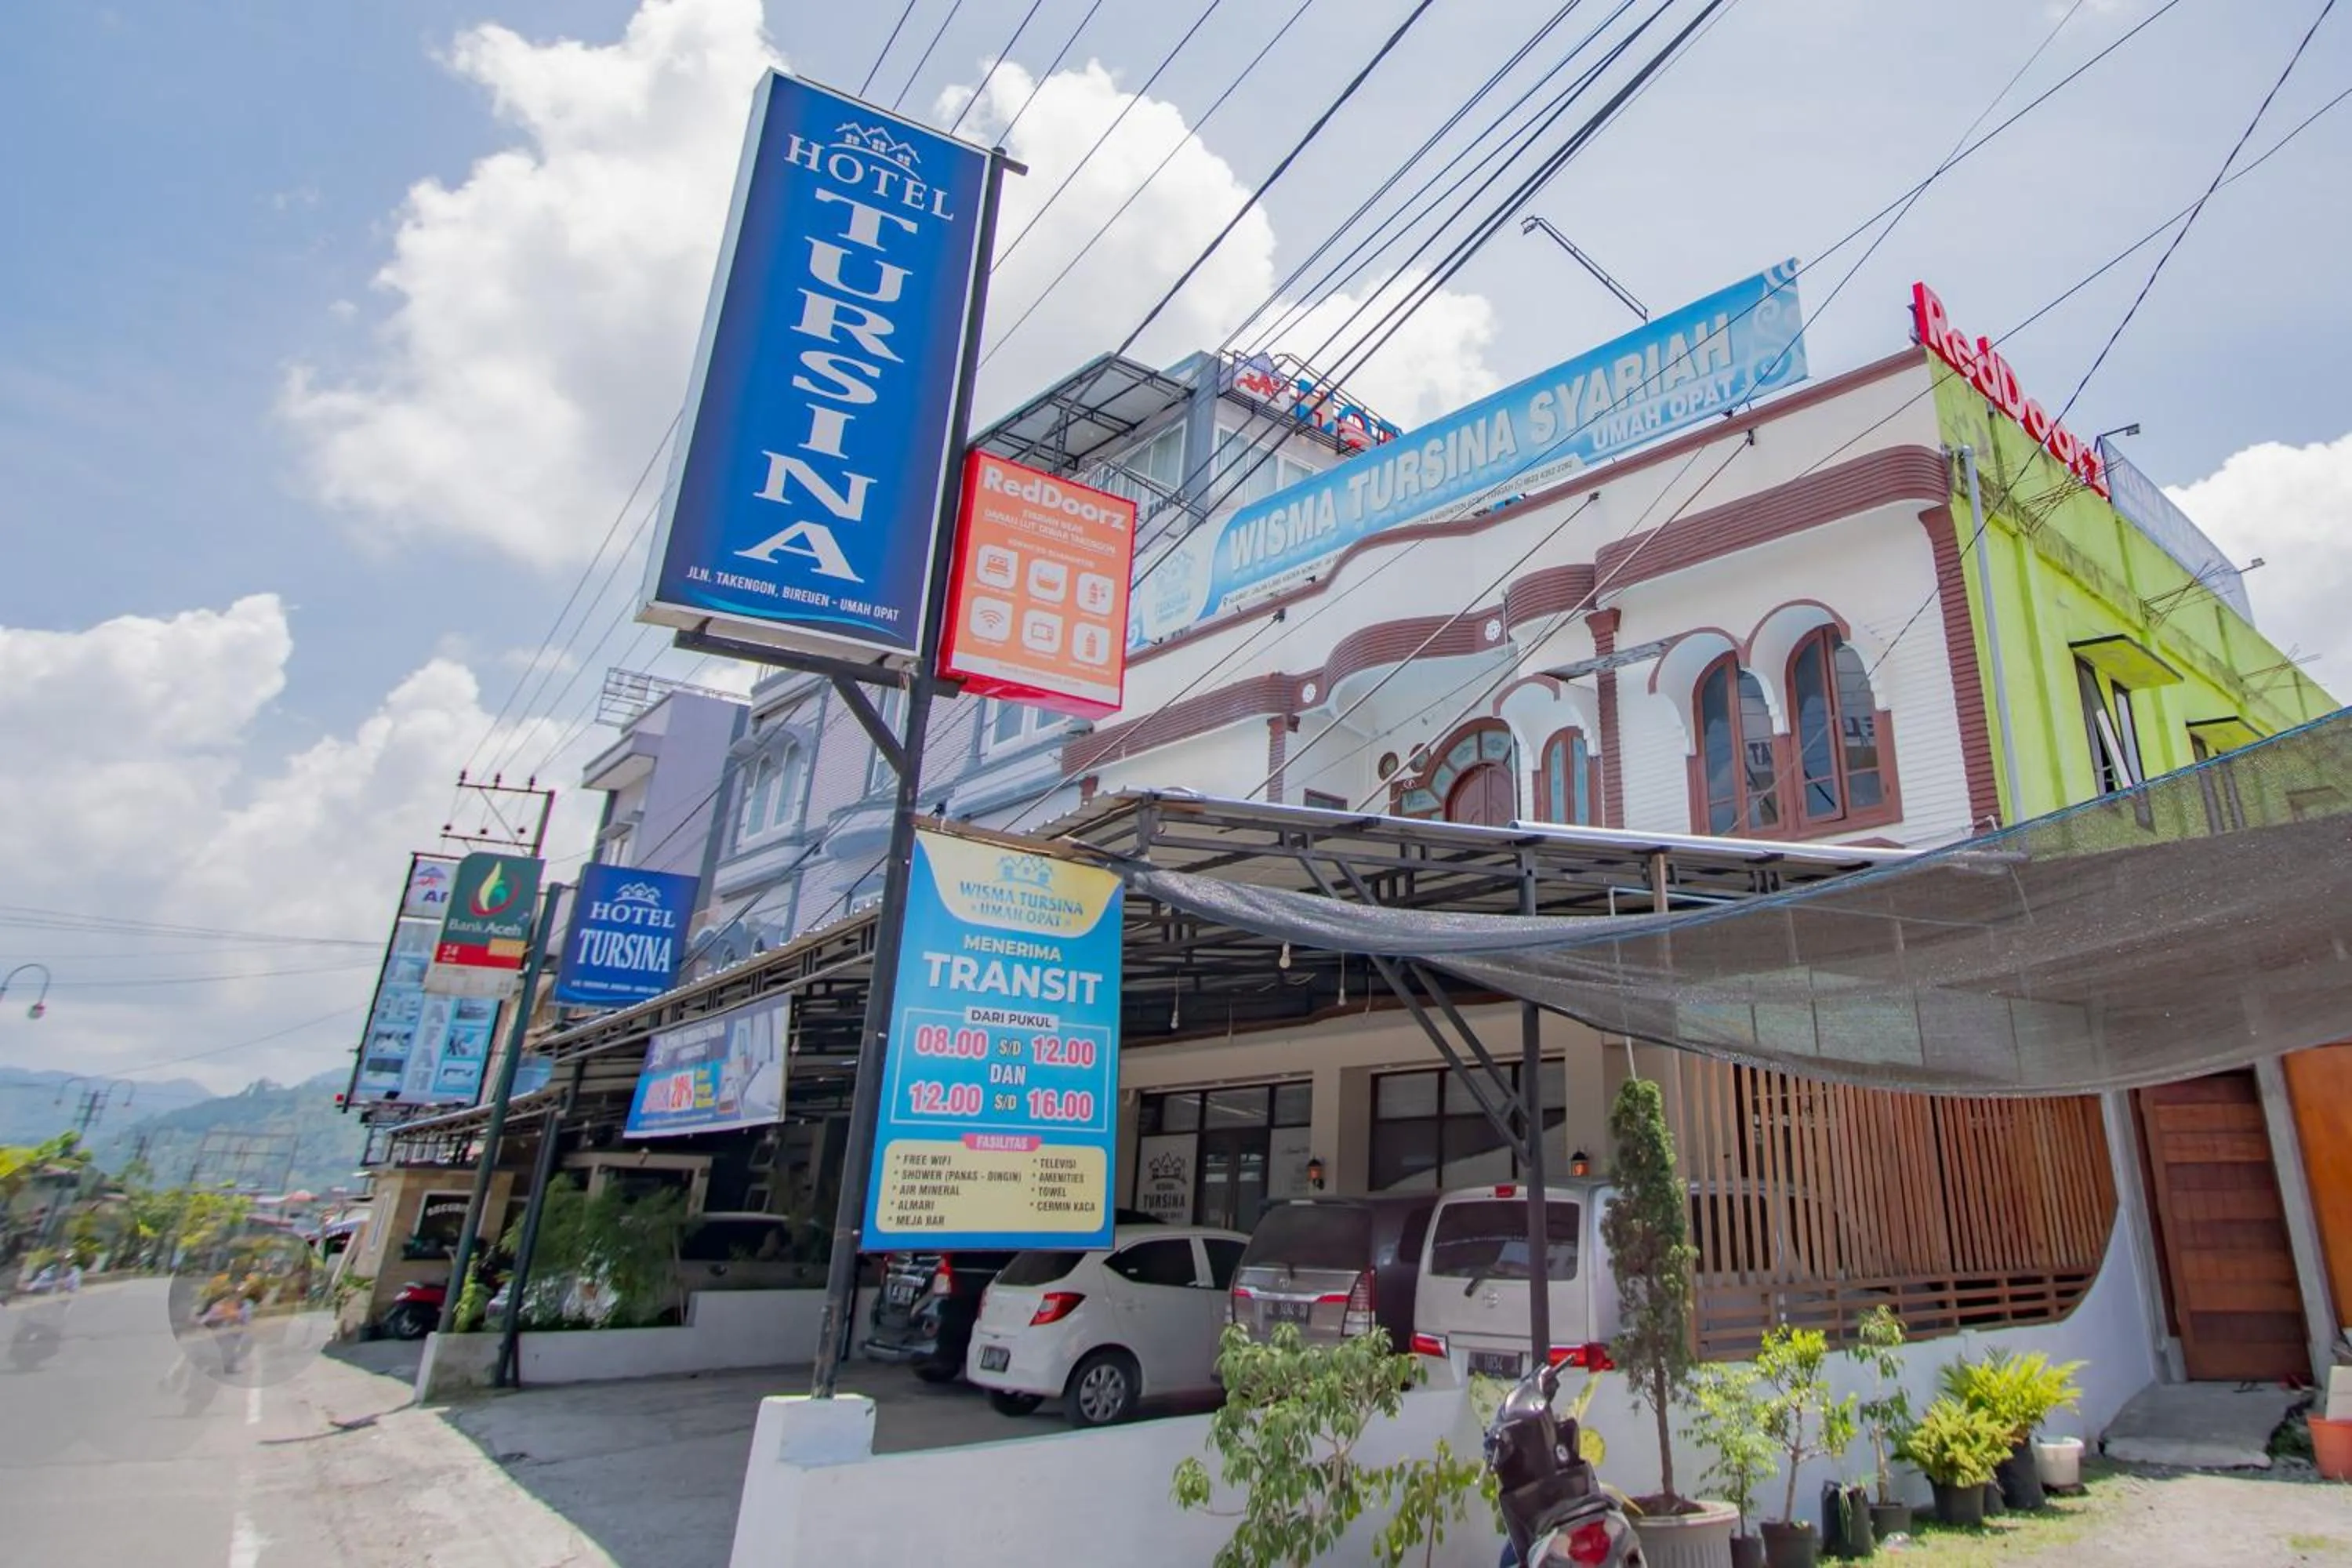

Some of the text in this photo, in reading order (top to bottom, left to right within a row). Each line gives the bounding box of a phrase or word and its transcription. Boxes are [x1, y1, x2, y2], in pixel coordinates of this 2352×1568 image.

[784, 133, 955, 221] HOTEL
[734, 188, 918, 583] TURSINA
[1590, 376, 1739, 453] UMAH OPAT
[1229, 314, 1736, 572] WISMA TURSINA SYARIAH
[982, 465, 1127, 533] RedDoorz
[782, 586, 831, 607] BIREUEN
[840, 598, 872, 616] UMAH
[873, 606, 900, 622] OPAT
[960, 880, 1083, 916] WISMA TURSINA
[590, 902, 676, 928] HOTEL
[448, 918, 522, 937] Bank Aceh
[577, 928, 673, 973] TURSINA
[964, 934, 1062, 963] MENERIMA
[923, 952, 1103, 1004] TRANSIT
[971, 1009, 1052, 1029] DARI PUKUL
[916, 1024, 1096, 1067] 08.00 S/D 12.00
[990, 1063, 1027, 1086] DAN
[909, 1080, 1094, 1120] 12.00 S/D 16.00
[976, 1137, 1029, 1151] FASILITAS
[903, 1154, 952, 1166] FREE WIFI
[1040, 1158, 1077, 1169] TELEVISI
[902, 1171, 942, 1182] SHOWER
[945, 1171, 978, 1182] (PANAS
[1039, 1172, 1084, 1185] AMENITIES
[899, 1185, 960, 1196] AIR MINERAL
[1038, 1186, 1067, 1198] TOWEL
[898, 1200, 935, 1211] ALMARI
[1036, 1202, 1096, 1212] CERMIN KACA
[896, 1216, 924, 1227] MEJA
